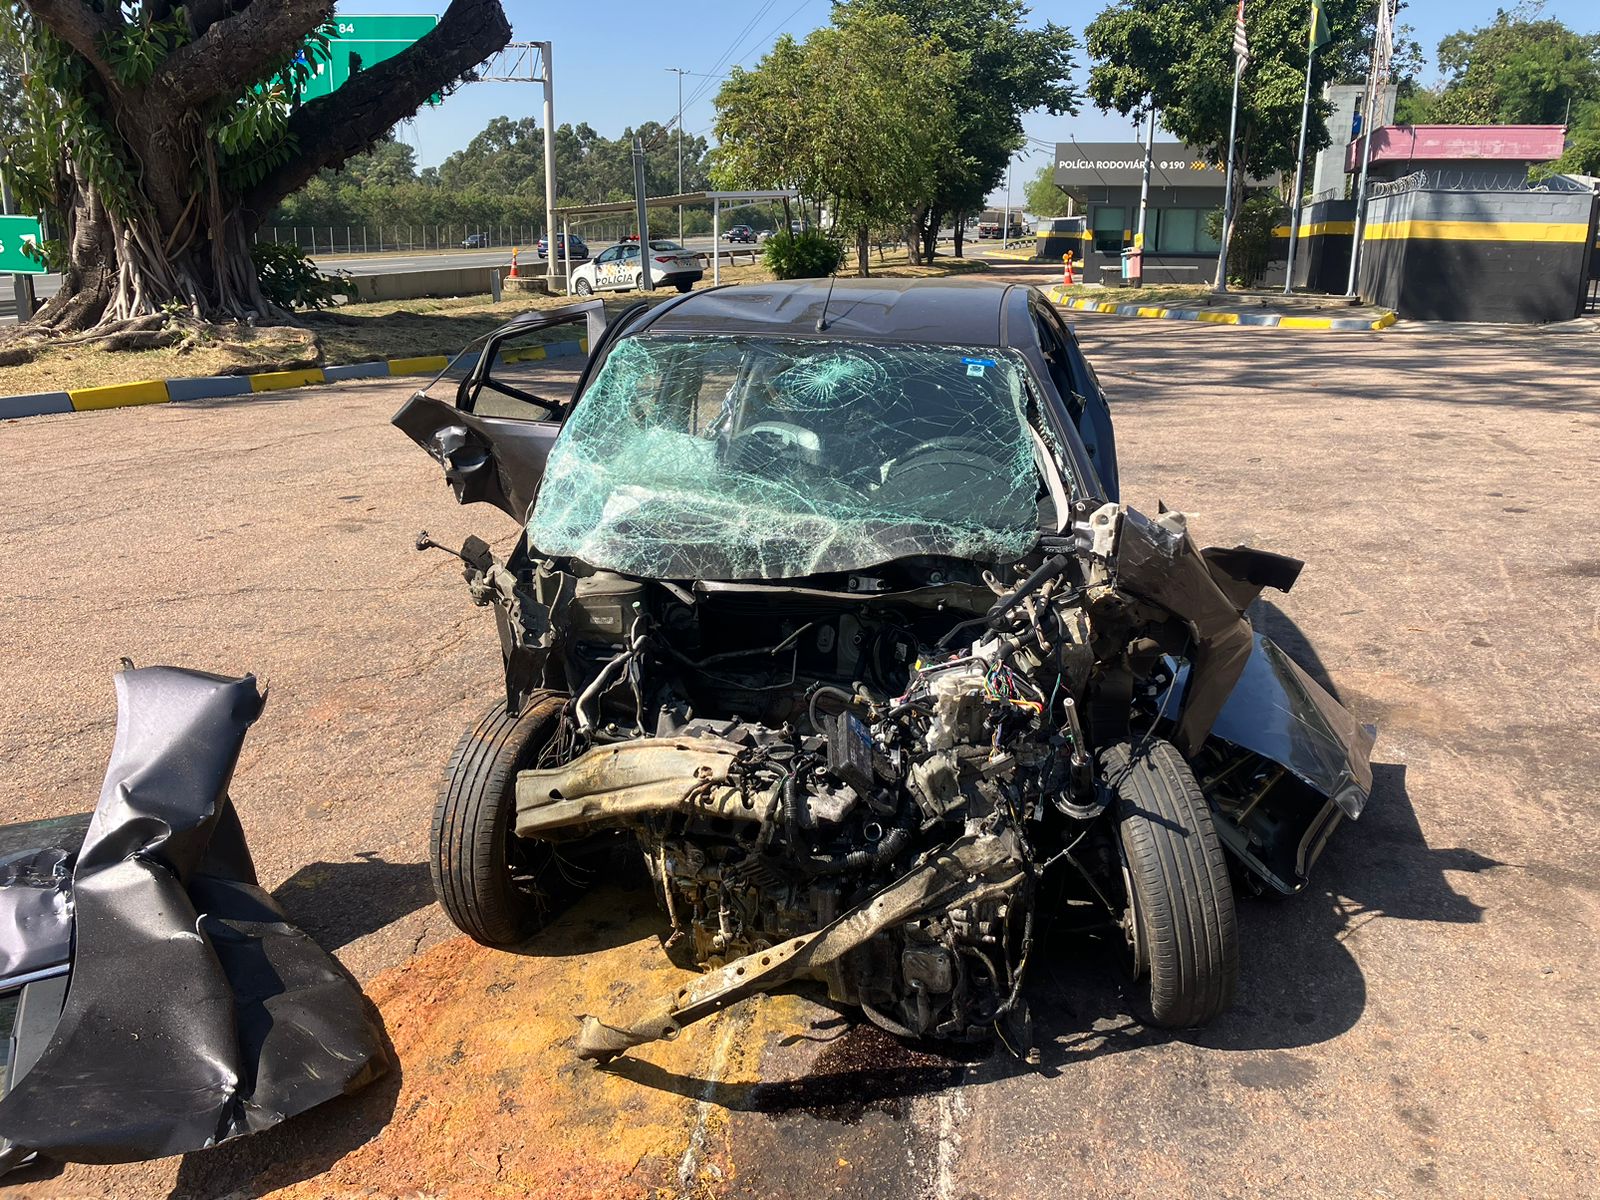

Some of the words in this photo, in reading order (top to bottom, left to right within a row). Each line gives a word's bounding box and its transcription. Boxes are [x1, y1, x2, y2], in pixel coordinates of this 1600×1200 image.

[338, 23, 355, 34] 84
[1059, 159, 1095, 169] POLÍCIA
[1096, 159, 1156, 169] RODOVIÁRA
[1169, 160, 1185, 170] 190
